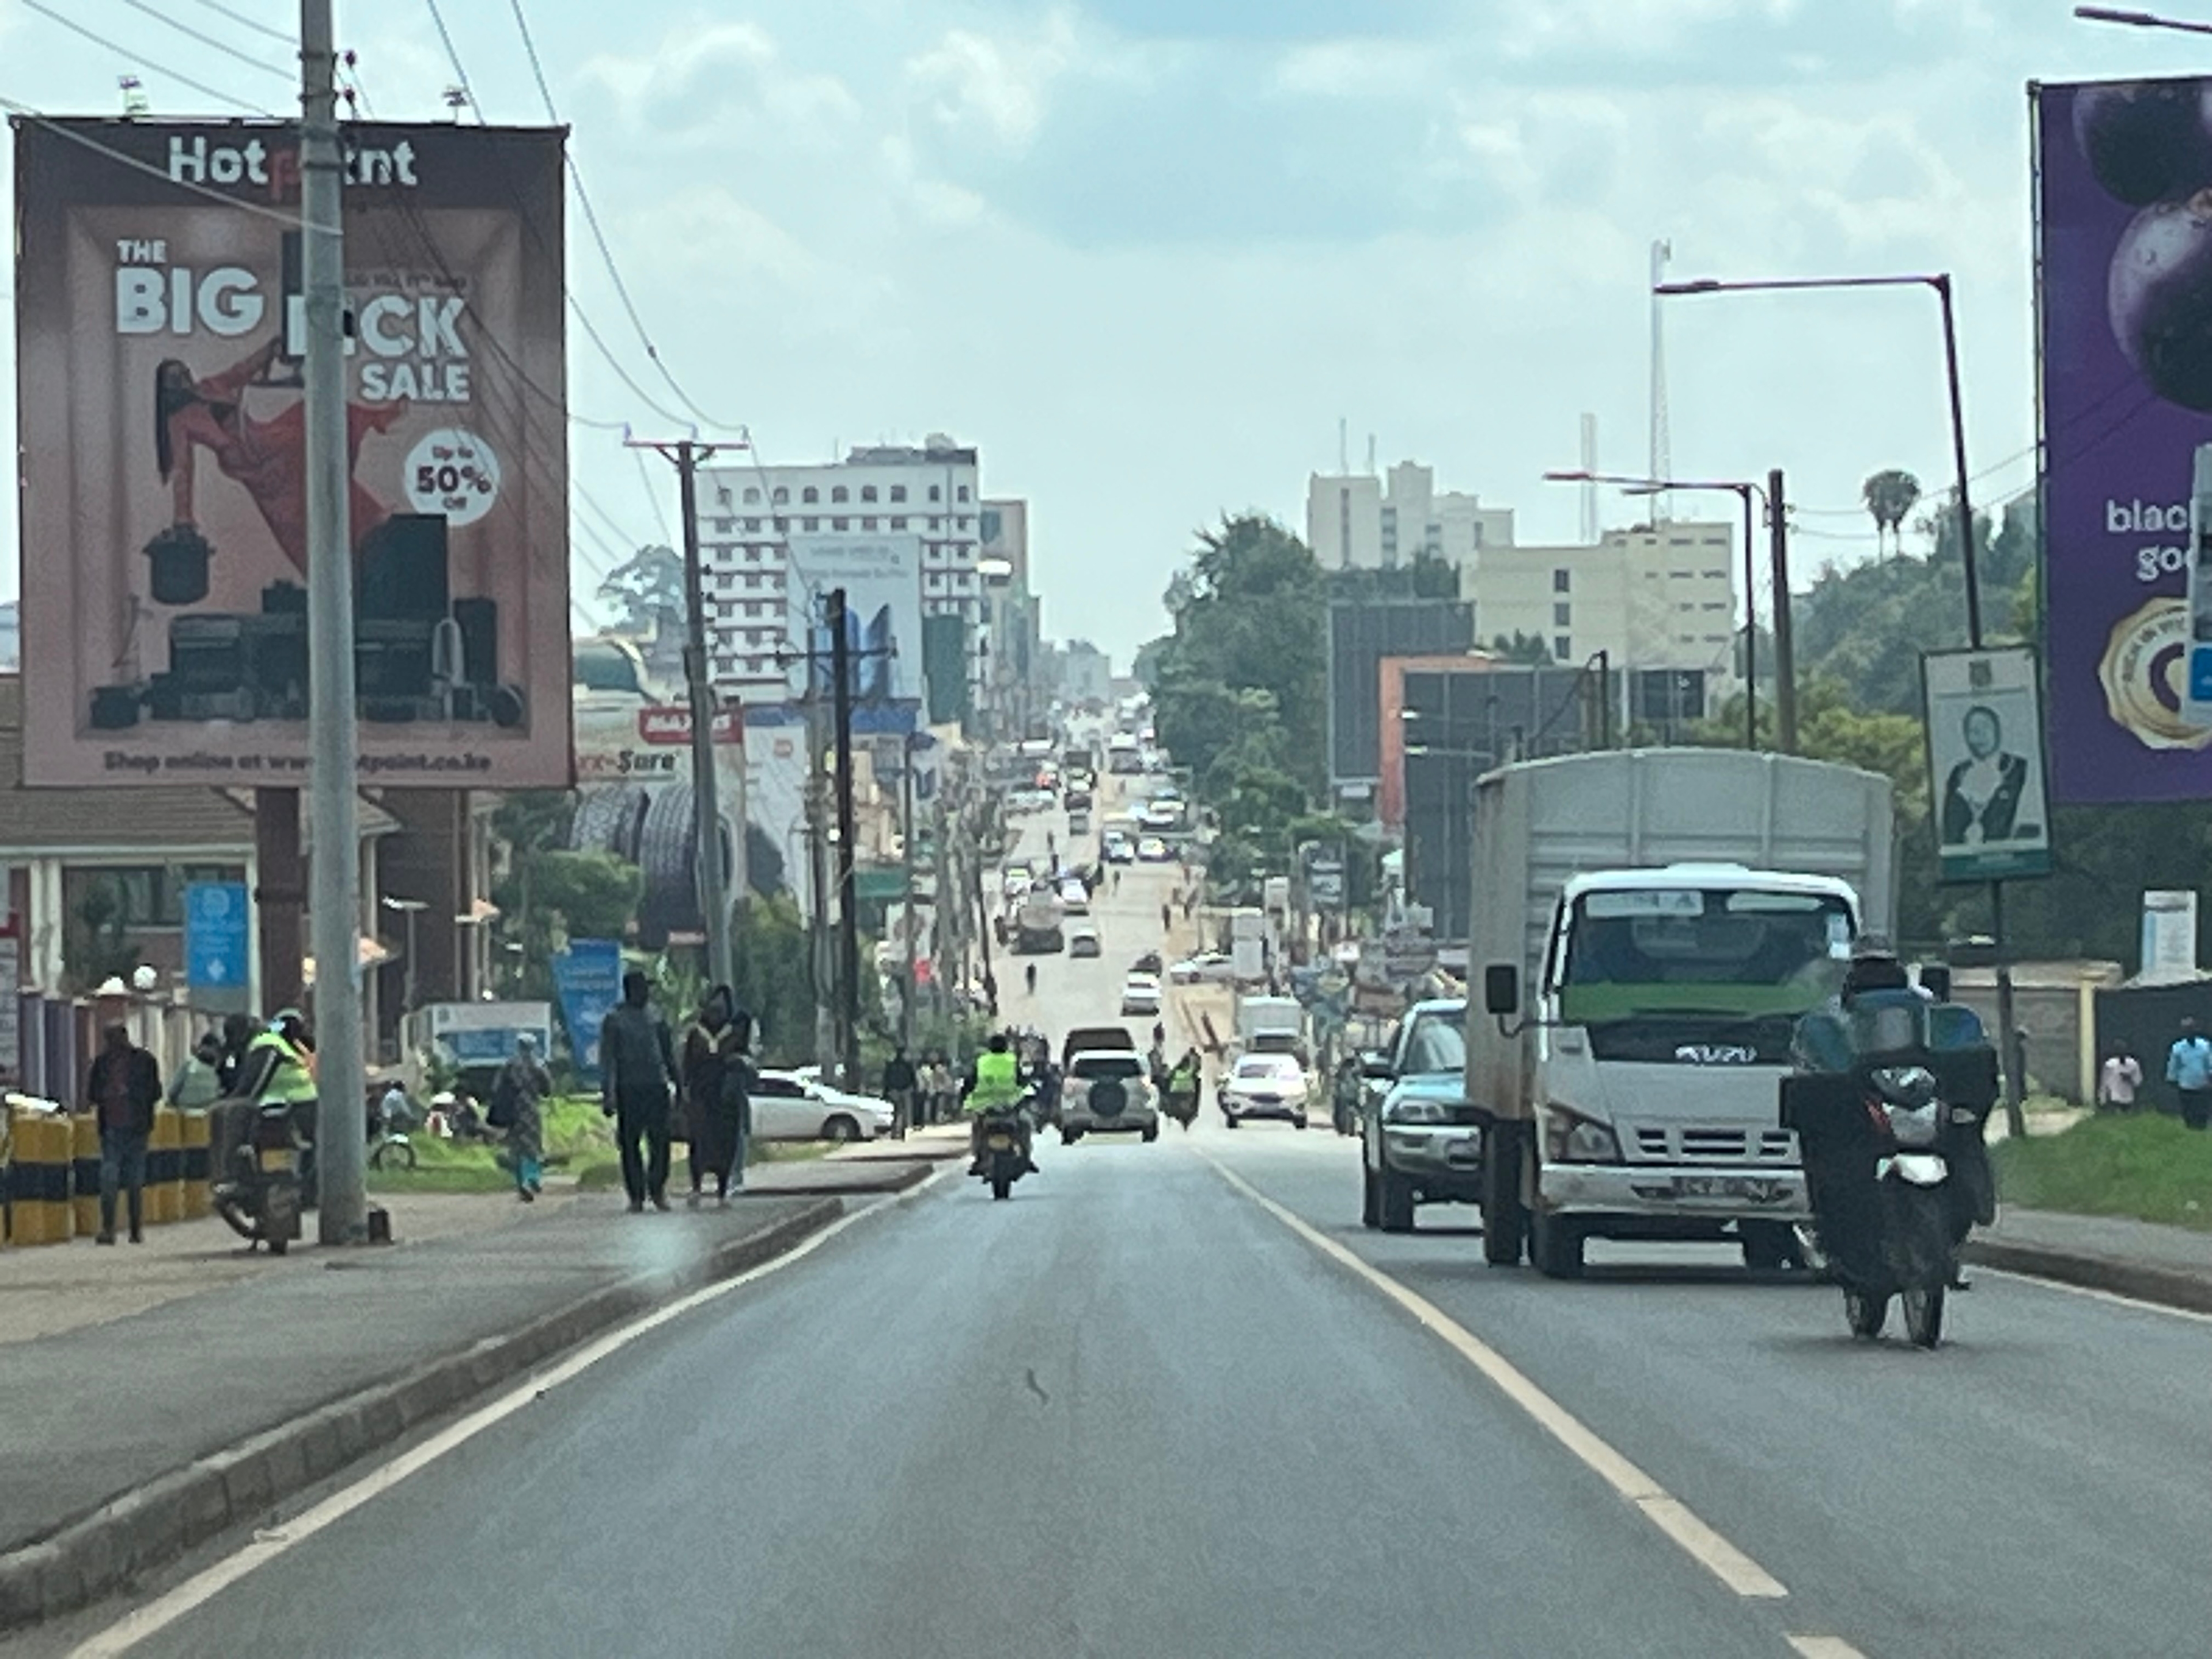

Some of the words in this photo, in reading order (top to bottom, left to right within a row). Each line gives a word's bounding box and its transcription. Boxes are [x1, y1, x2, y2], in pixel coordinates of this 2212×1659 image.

[168, 137, 418, 200] Hotpnt
[117, 240, 166, 263] THE
[117, 268, 263, 336] BIG
[287, 294, 469, 358] CK
[362, 363, 469, 402] SALE
[418, 465, 491, 494] 50%
